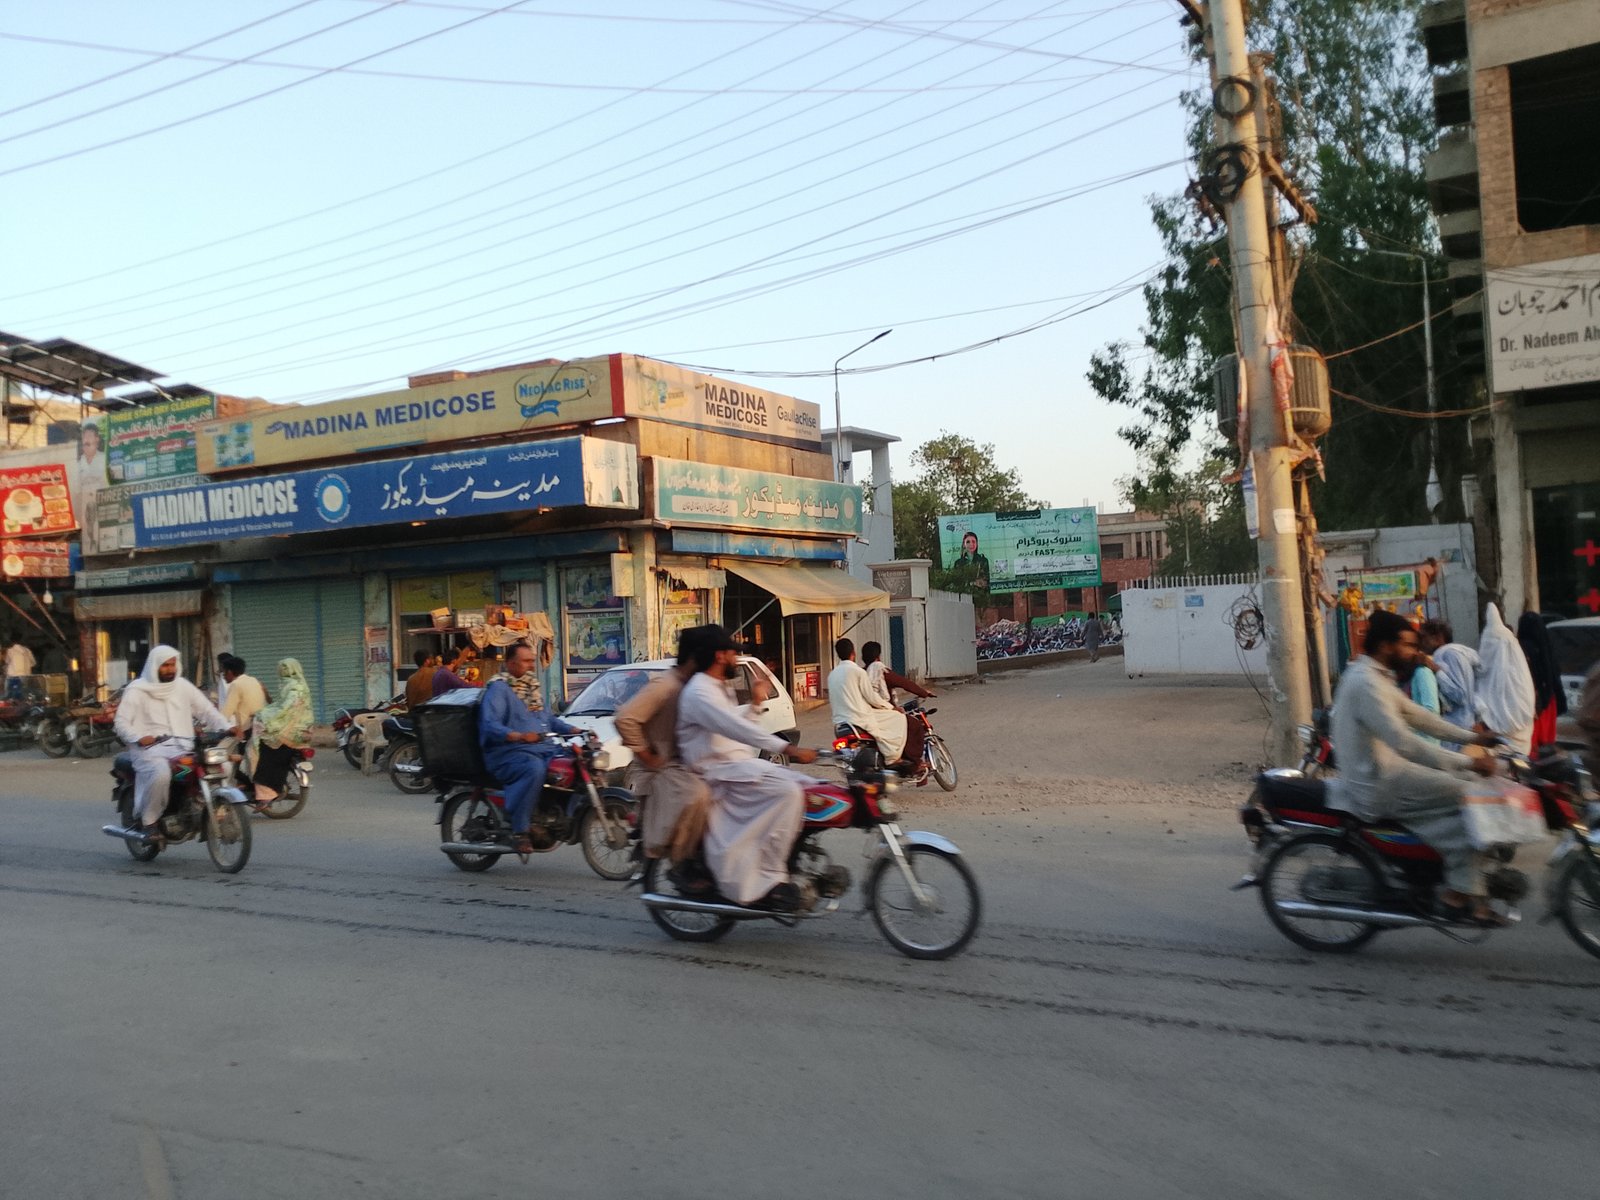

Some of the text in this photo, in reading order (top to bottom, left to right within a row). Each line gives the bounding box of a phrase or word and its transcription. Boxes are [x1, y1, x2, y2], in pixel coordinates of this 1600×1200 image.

[1500, 336, 1518, 352] Dr.
[1523, 331, 1579, 350] Nadeem
[704, 382, 767, 413] MADINA
[284, 411, 368, 440] MADINA
[374, 390, 497, 427] MEDICOSE
[705, 401, 768, 427] MEDICOSE
[380, 460, 475, 516] میڈیکوز
[471, 473, 560, 502] مدینہ
[742, 481, 802, 521] میڈیکوز
[142, 490, 208, 528] MADINA
[207, 479, 299, 521] MEDICOSE
[802, 495, 840, 525] مدینہ
[1035, 548, 1055, 556] FAST
